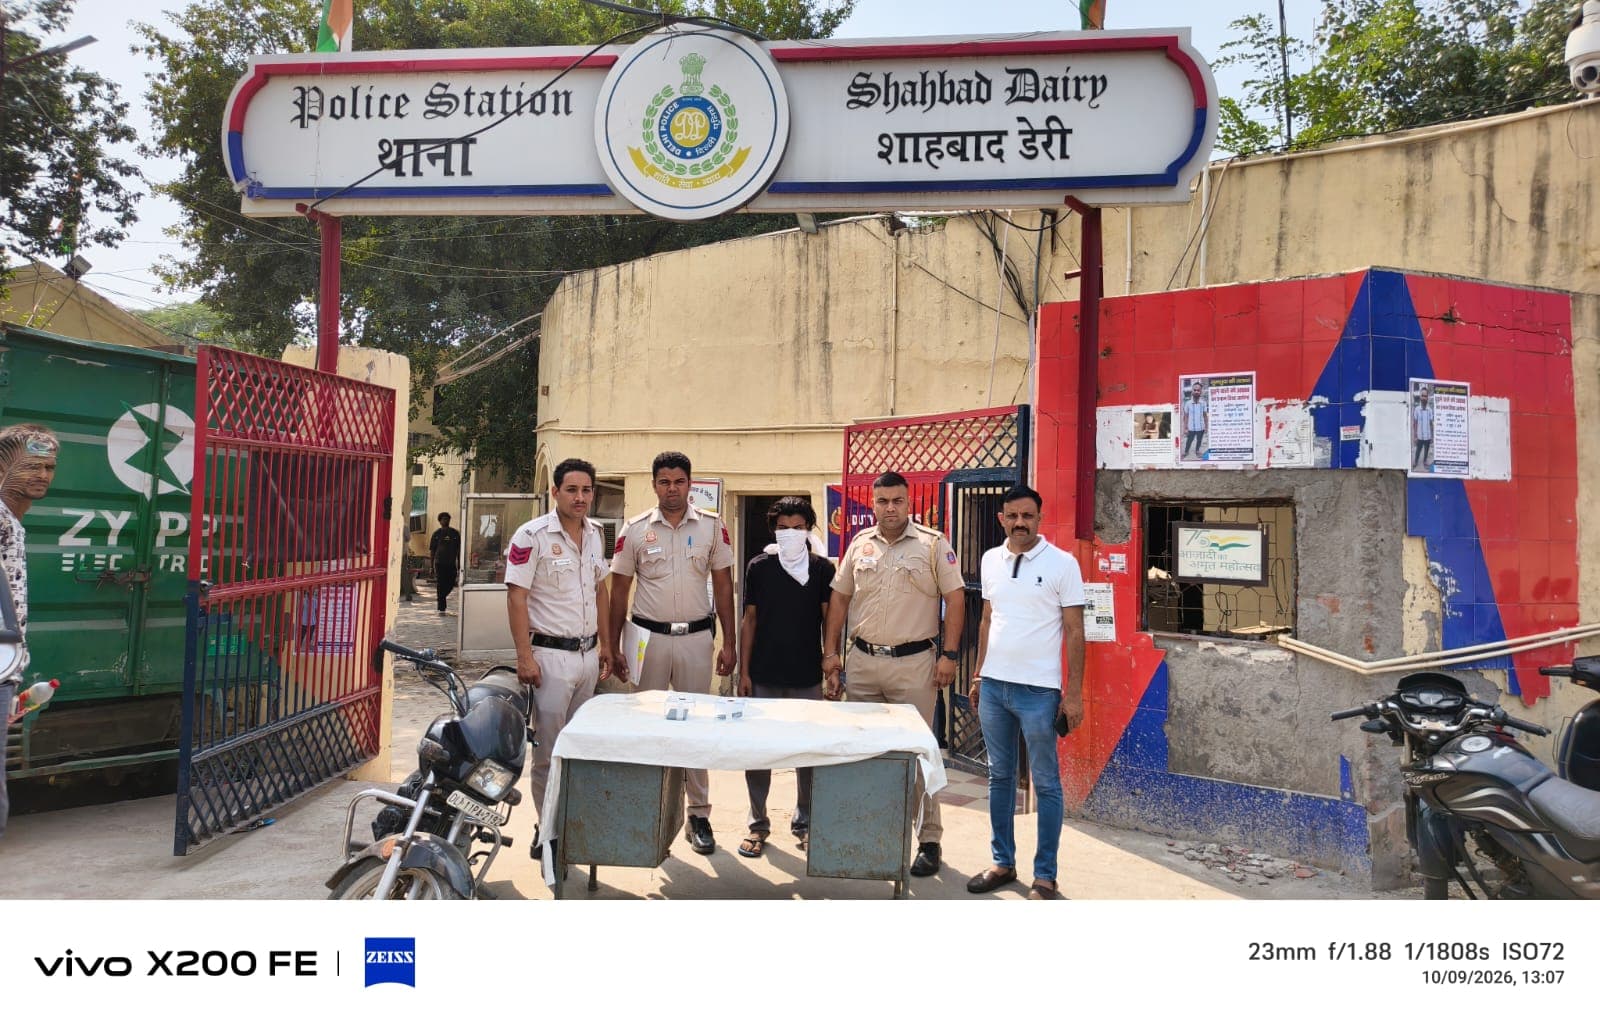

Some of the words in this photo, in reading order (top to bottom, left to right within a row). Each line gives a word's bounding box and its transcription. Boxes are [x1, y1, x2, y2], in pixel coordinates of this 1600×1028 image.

[290, 85, 410, 129] Police
[423, 82, 573, 119] Station
[845, 70, 993, 113] Shahbad
[1005, 66, 1108, 109] Dairy
[660, 102, 680, 132] POLICE
[378, 136, 478, 177] थाना
[877, 130, 1009, 170] शाहबाद
[1018, 114, 1073, 161] डेरी
